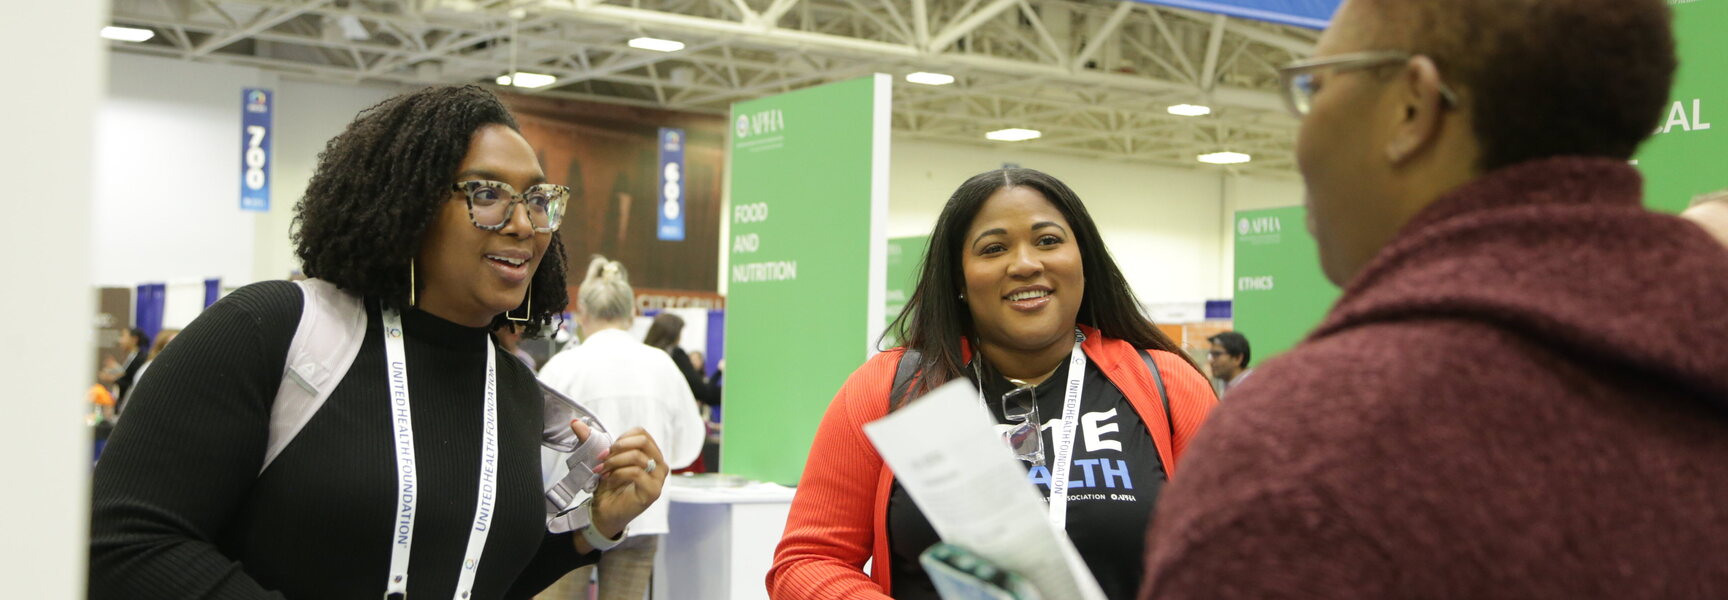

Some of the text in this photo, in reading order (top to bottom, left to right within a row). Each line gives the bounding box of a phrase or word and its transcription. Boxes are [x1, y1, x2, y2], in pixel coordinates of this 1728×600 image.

[1653, 98, 1711, 135] AL
[246, 124, 266, 191] 700
[664, 161, 680, 220] 600
[734, 202, 769, 224] FOOD
[733, 233, 760, 254] AND
[732, 261, 797, 283] NUTRITION
[1238, 275, 1274, 291] ETHICS
[636, 294, 674, 311] CITY
[392, 361, 413, 545] UNITED HEALTH FOUNDATION
[475, 367, 495, 532] UNITED HEALTH FOUNDATION
[1054, 379, 1080, 494] UNITED HEALTH FOUNDATION
